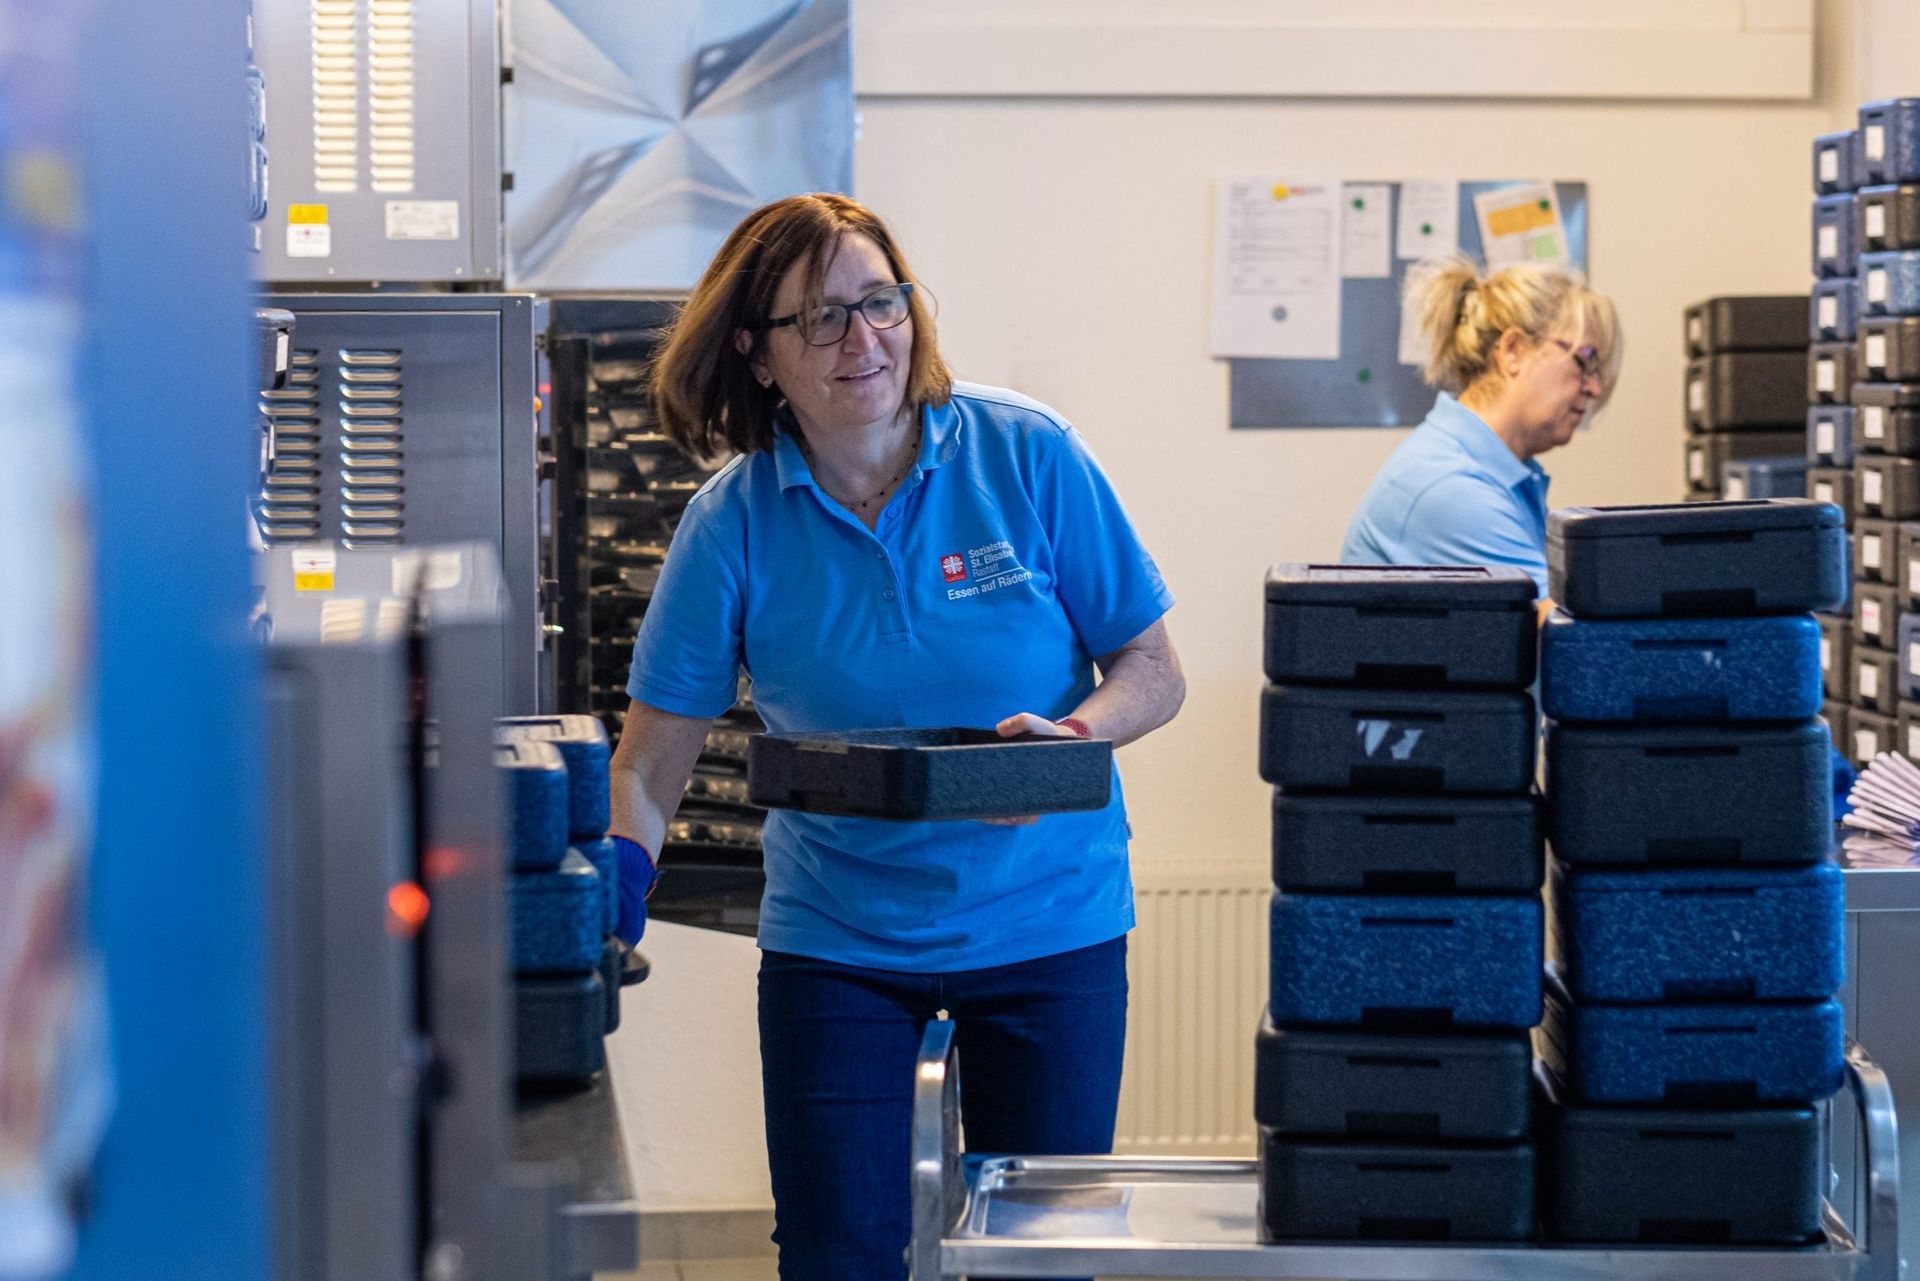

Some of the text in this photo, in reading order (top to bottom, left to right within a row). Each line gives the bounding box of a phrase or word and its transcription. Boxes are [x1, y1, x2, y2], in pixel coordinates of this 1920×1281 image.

[971, 559, 983, 568] St.
[973, 563, 999, 577] Rastatt
[947, 571, 1033, 600] Essen auf Rädern
